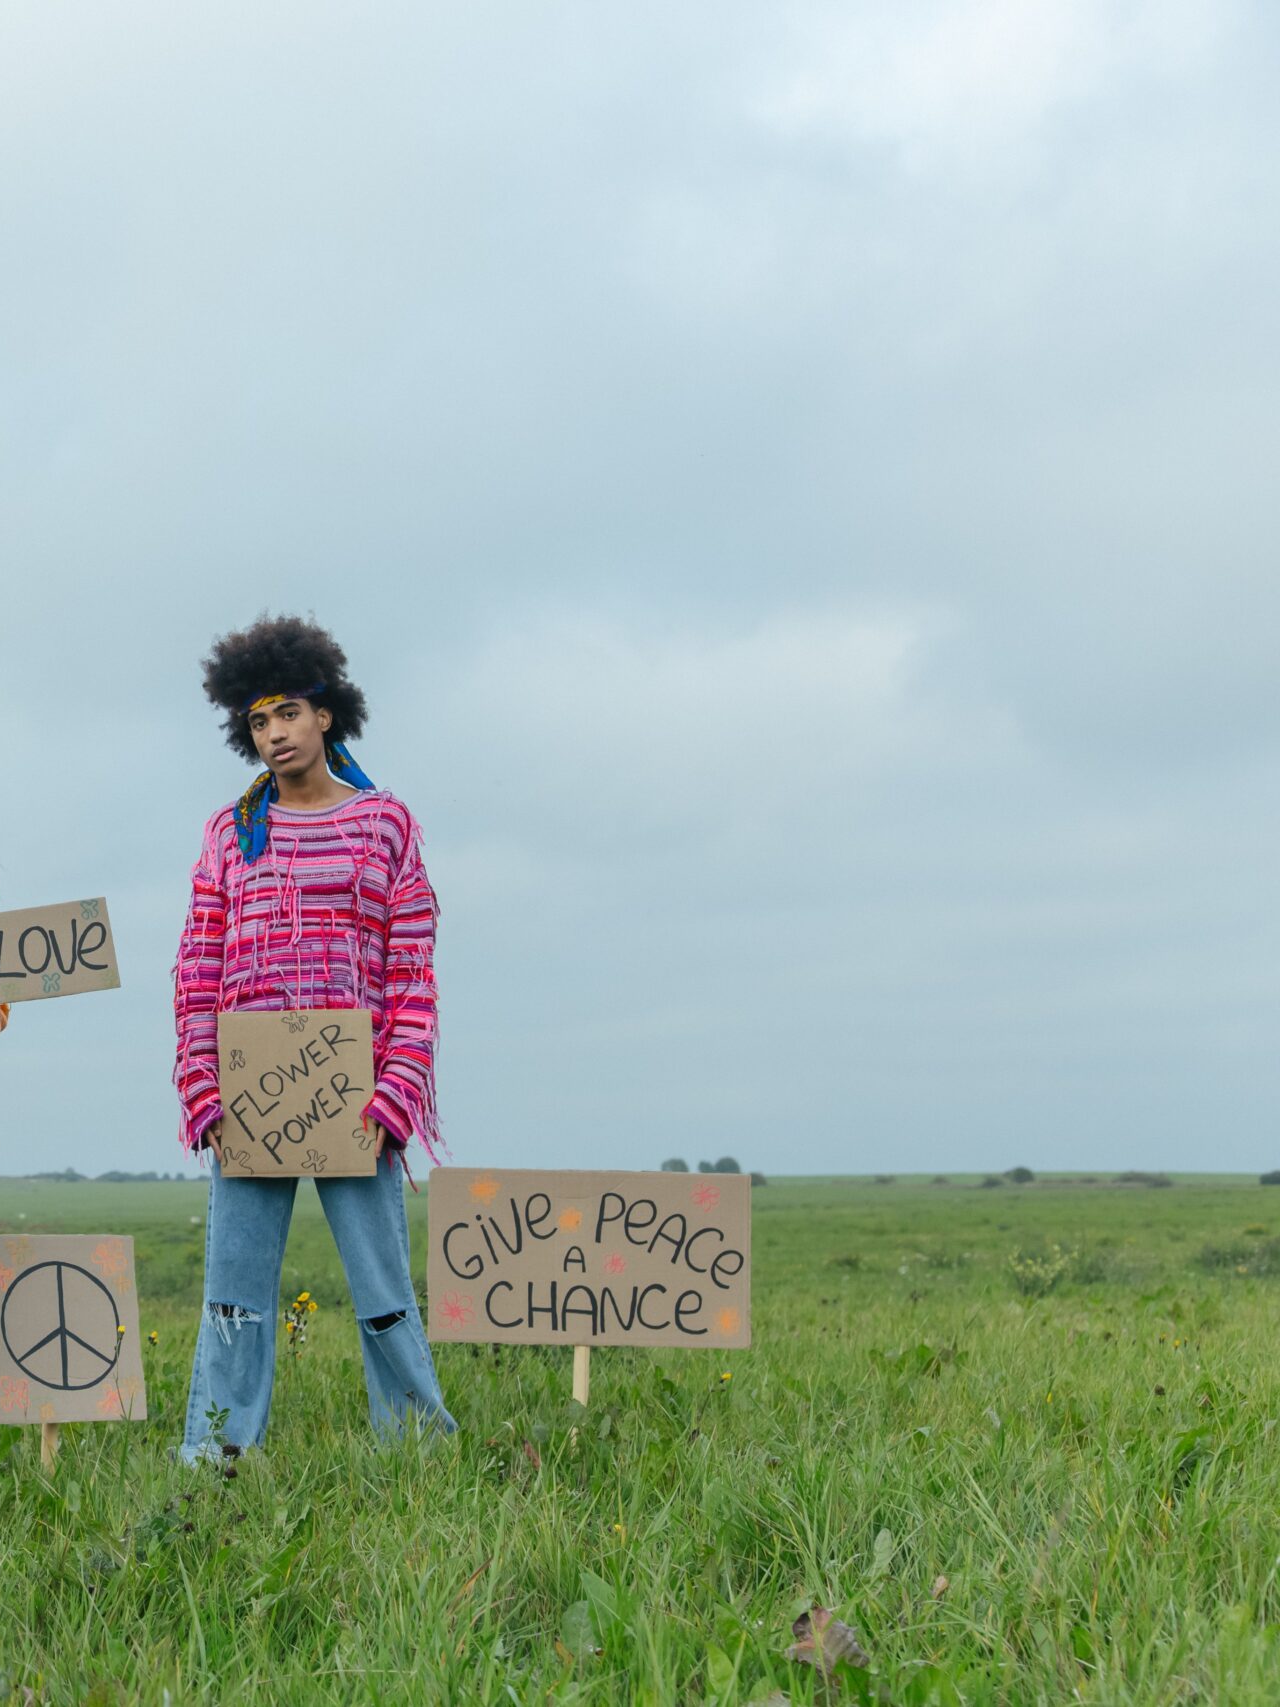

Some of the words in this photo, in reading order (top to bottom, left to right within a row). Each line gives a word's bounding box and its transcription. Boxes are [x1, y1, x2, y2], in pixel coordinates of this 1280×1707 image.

[229, 1024, 358, 1142] FLOWER
[261, 1072, 365, 1165] POWER
[563, 1246, 586, 1273] A
